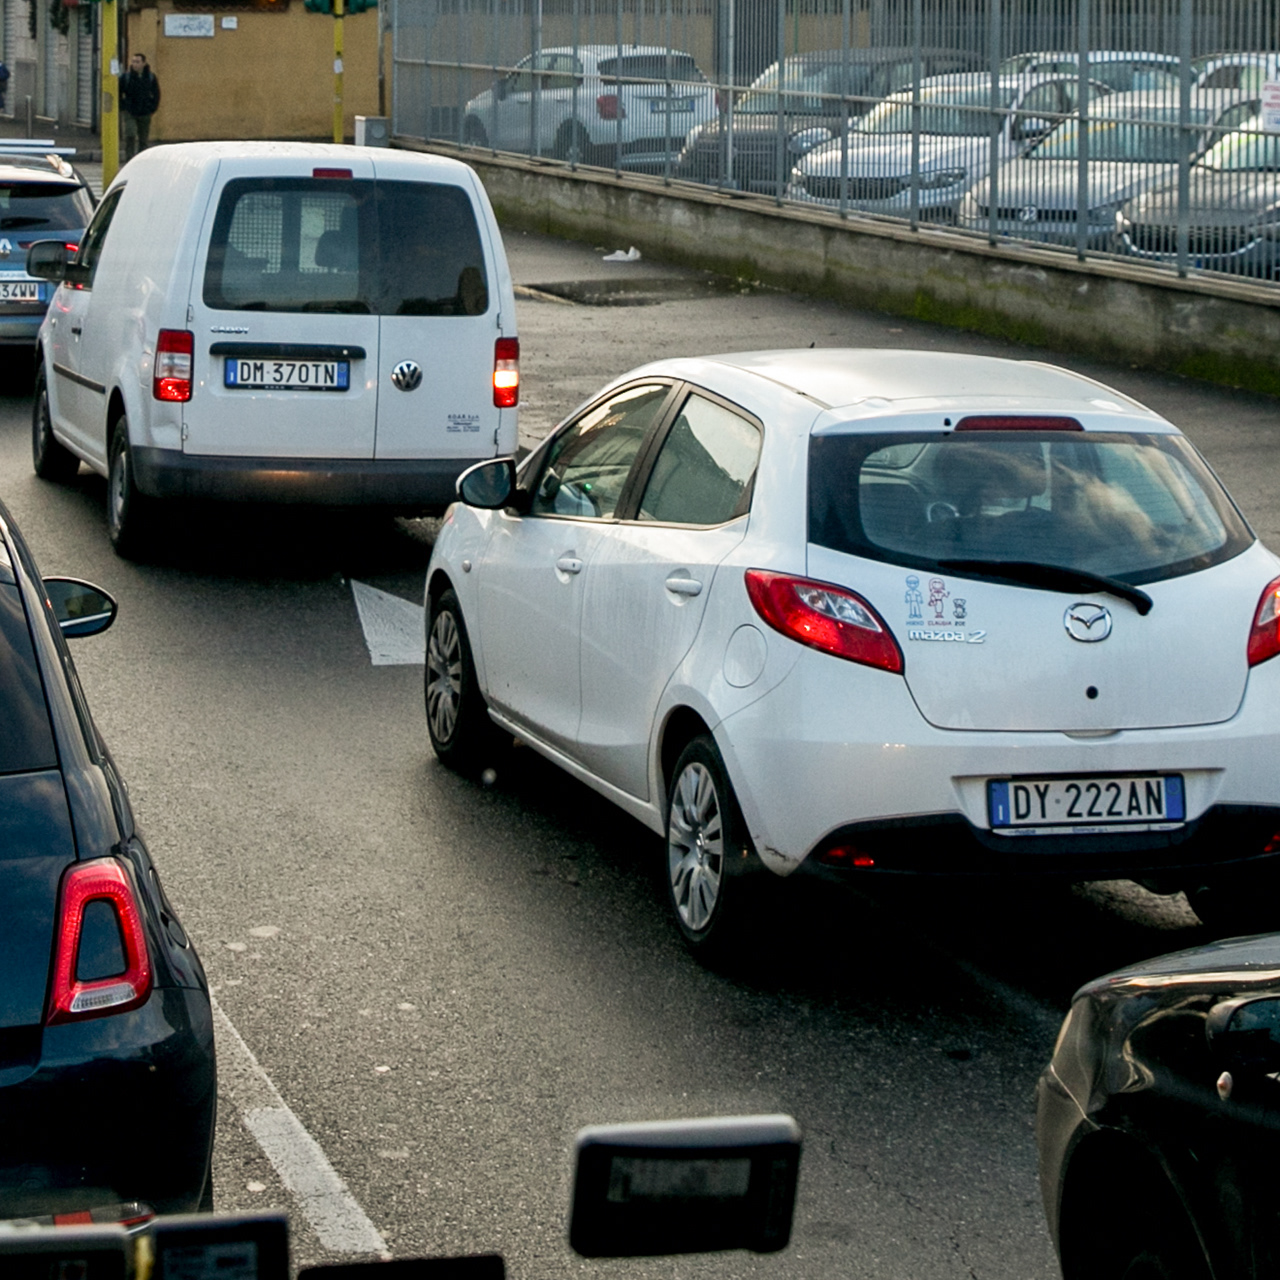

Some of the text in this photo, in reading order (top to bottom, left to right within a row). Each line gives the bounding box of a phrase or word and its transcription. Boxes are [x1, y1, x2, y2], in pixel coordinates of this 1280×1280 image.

[210, 325, 249, 334] CADDY
[240, 362, 264, 382] DM
[273, 363, 335, 384] 370TN
[967, 630, 986, 644] 2
[1014, 784, 1050, 820] DY
[1065, 781, 1163, 818] 222AN
